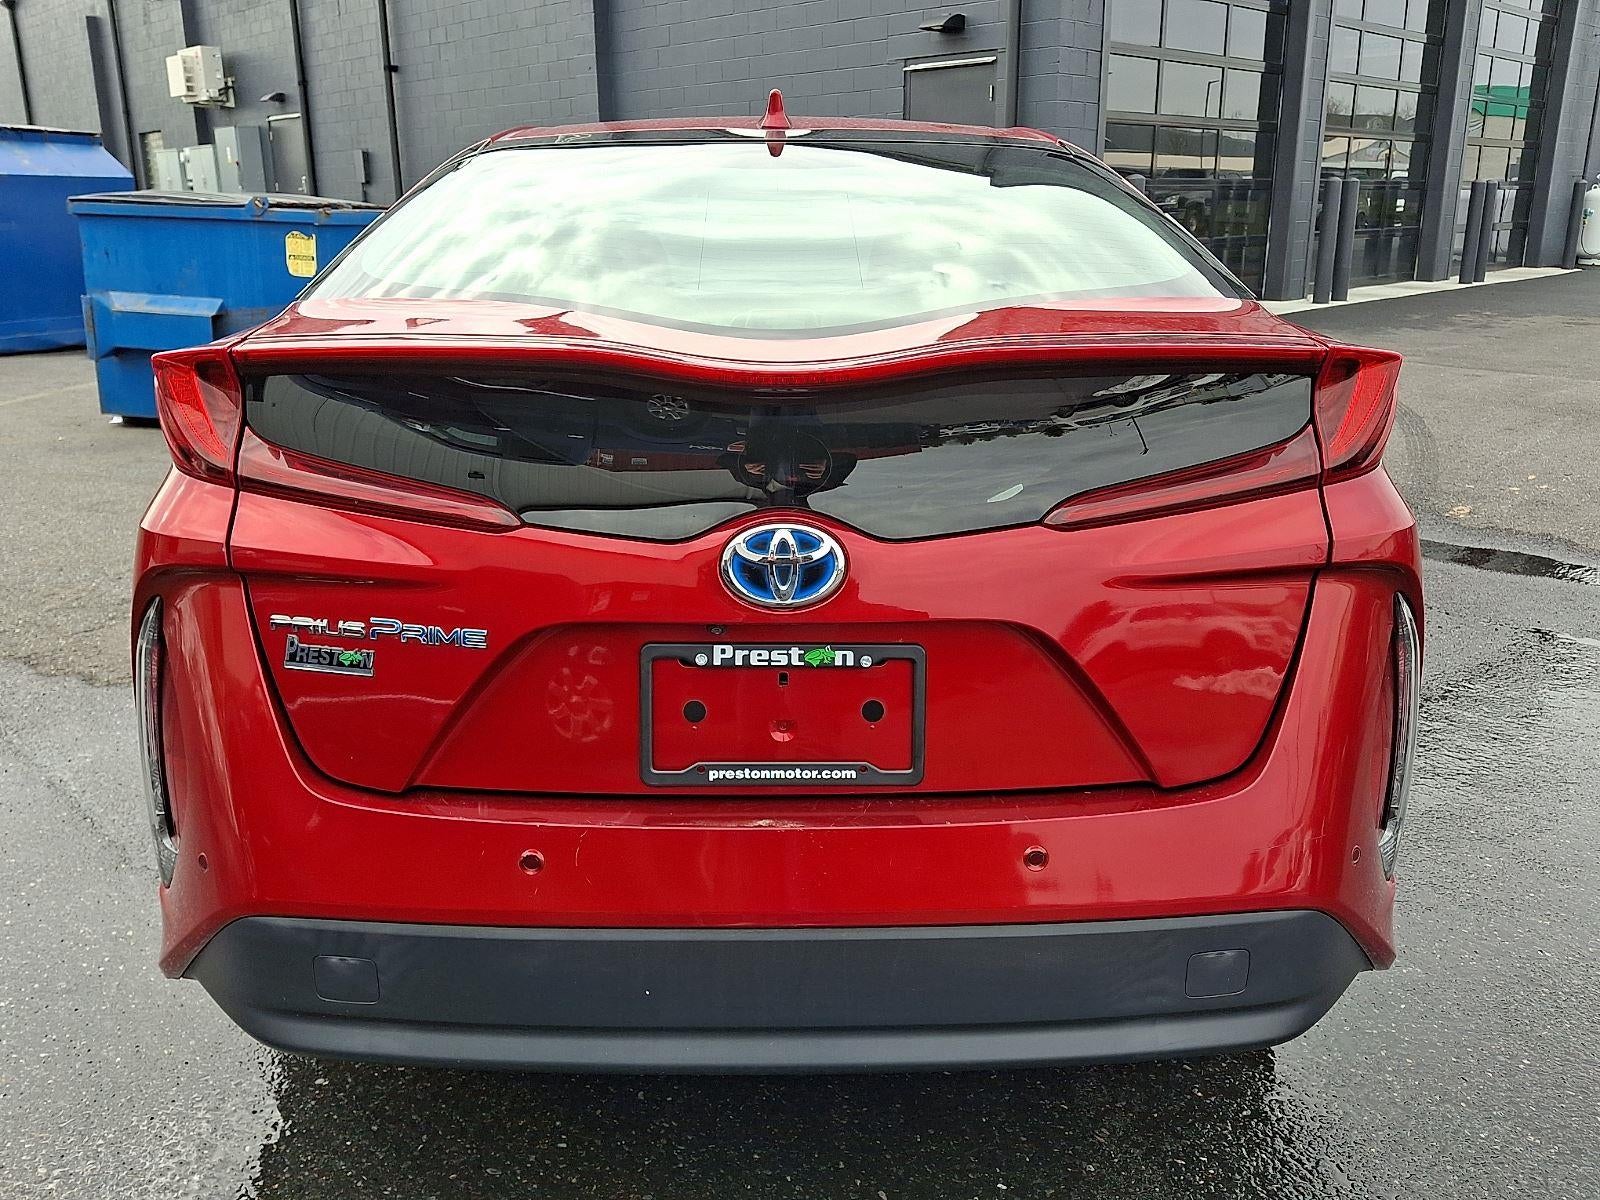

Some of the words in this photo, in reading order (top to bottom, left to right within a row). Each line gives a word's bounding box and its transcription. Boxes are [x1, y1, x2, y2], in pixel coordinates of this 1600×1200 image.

[269, 614, 367, 638] PRIUS
[369, 616, 488, 649] PRIME
[286, 634, 374, 669] PRESTN
[712, 644, 855, 668] Prestn
[708, 767, 857, 782] prestonmotor.com
